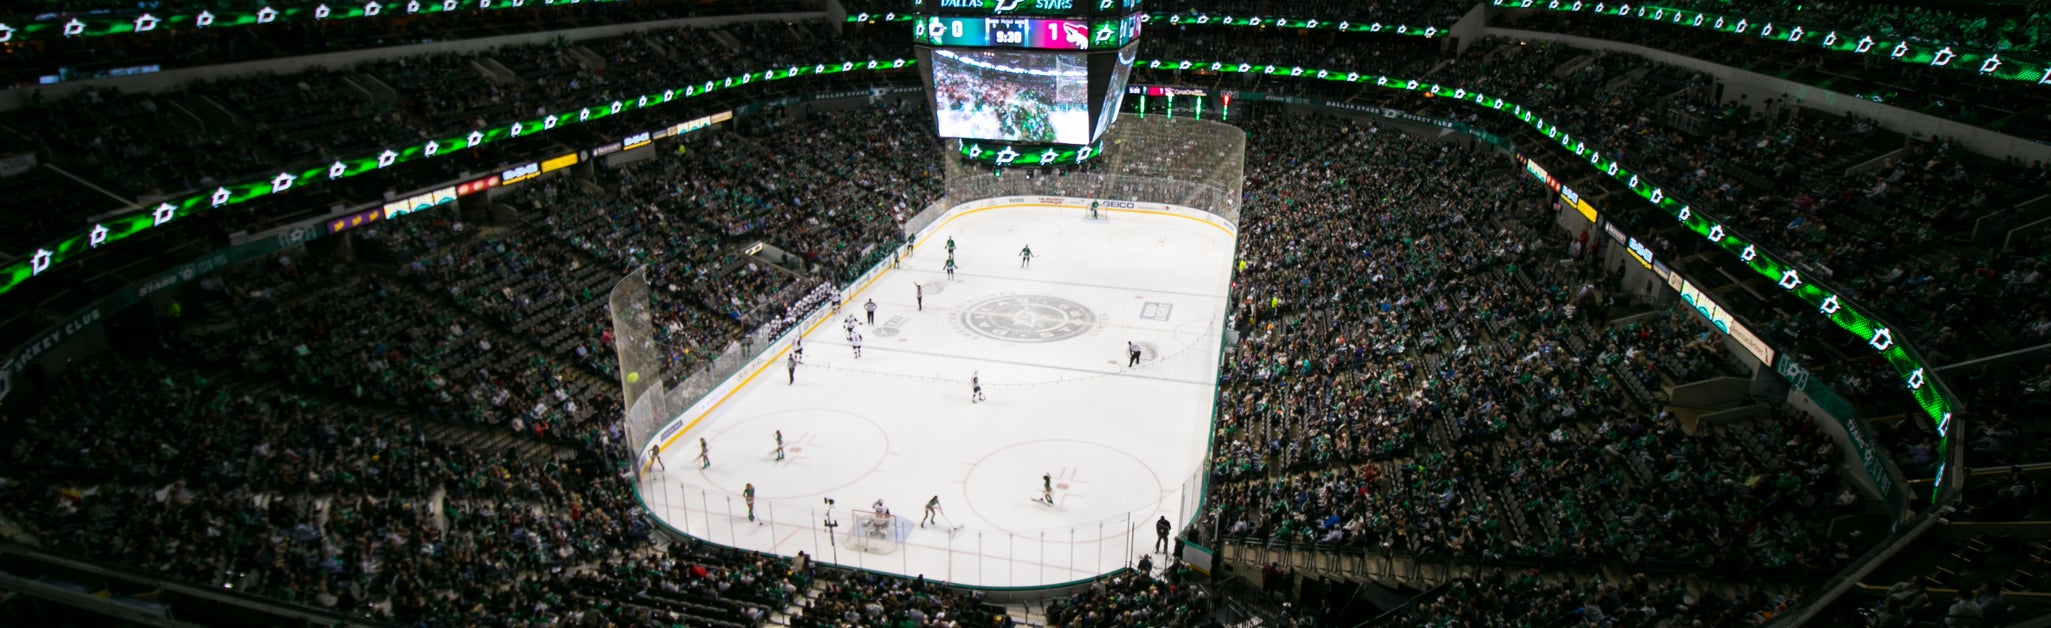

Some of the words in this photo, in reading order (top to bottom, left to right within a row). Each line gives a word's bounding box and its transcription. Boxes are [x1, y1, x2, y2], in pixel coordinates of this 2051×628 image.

[940, 0, 983, 8] DALLAS
[1035, 0, 1073, 9] STARS
[951, 20, 963, 37] 0
[996, 30, 1022, 44] 9:30
[1048, 23, 1058, 40] 1
[1326, 100, 1355, 110] DALLAS
[1356, 103, 1380, 114] STARS
[1433, 119, 1453, 128] CLUB
[1103, 200, 1135, 209] GEICO
[65, 309, 101, 335] CLUB
